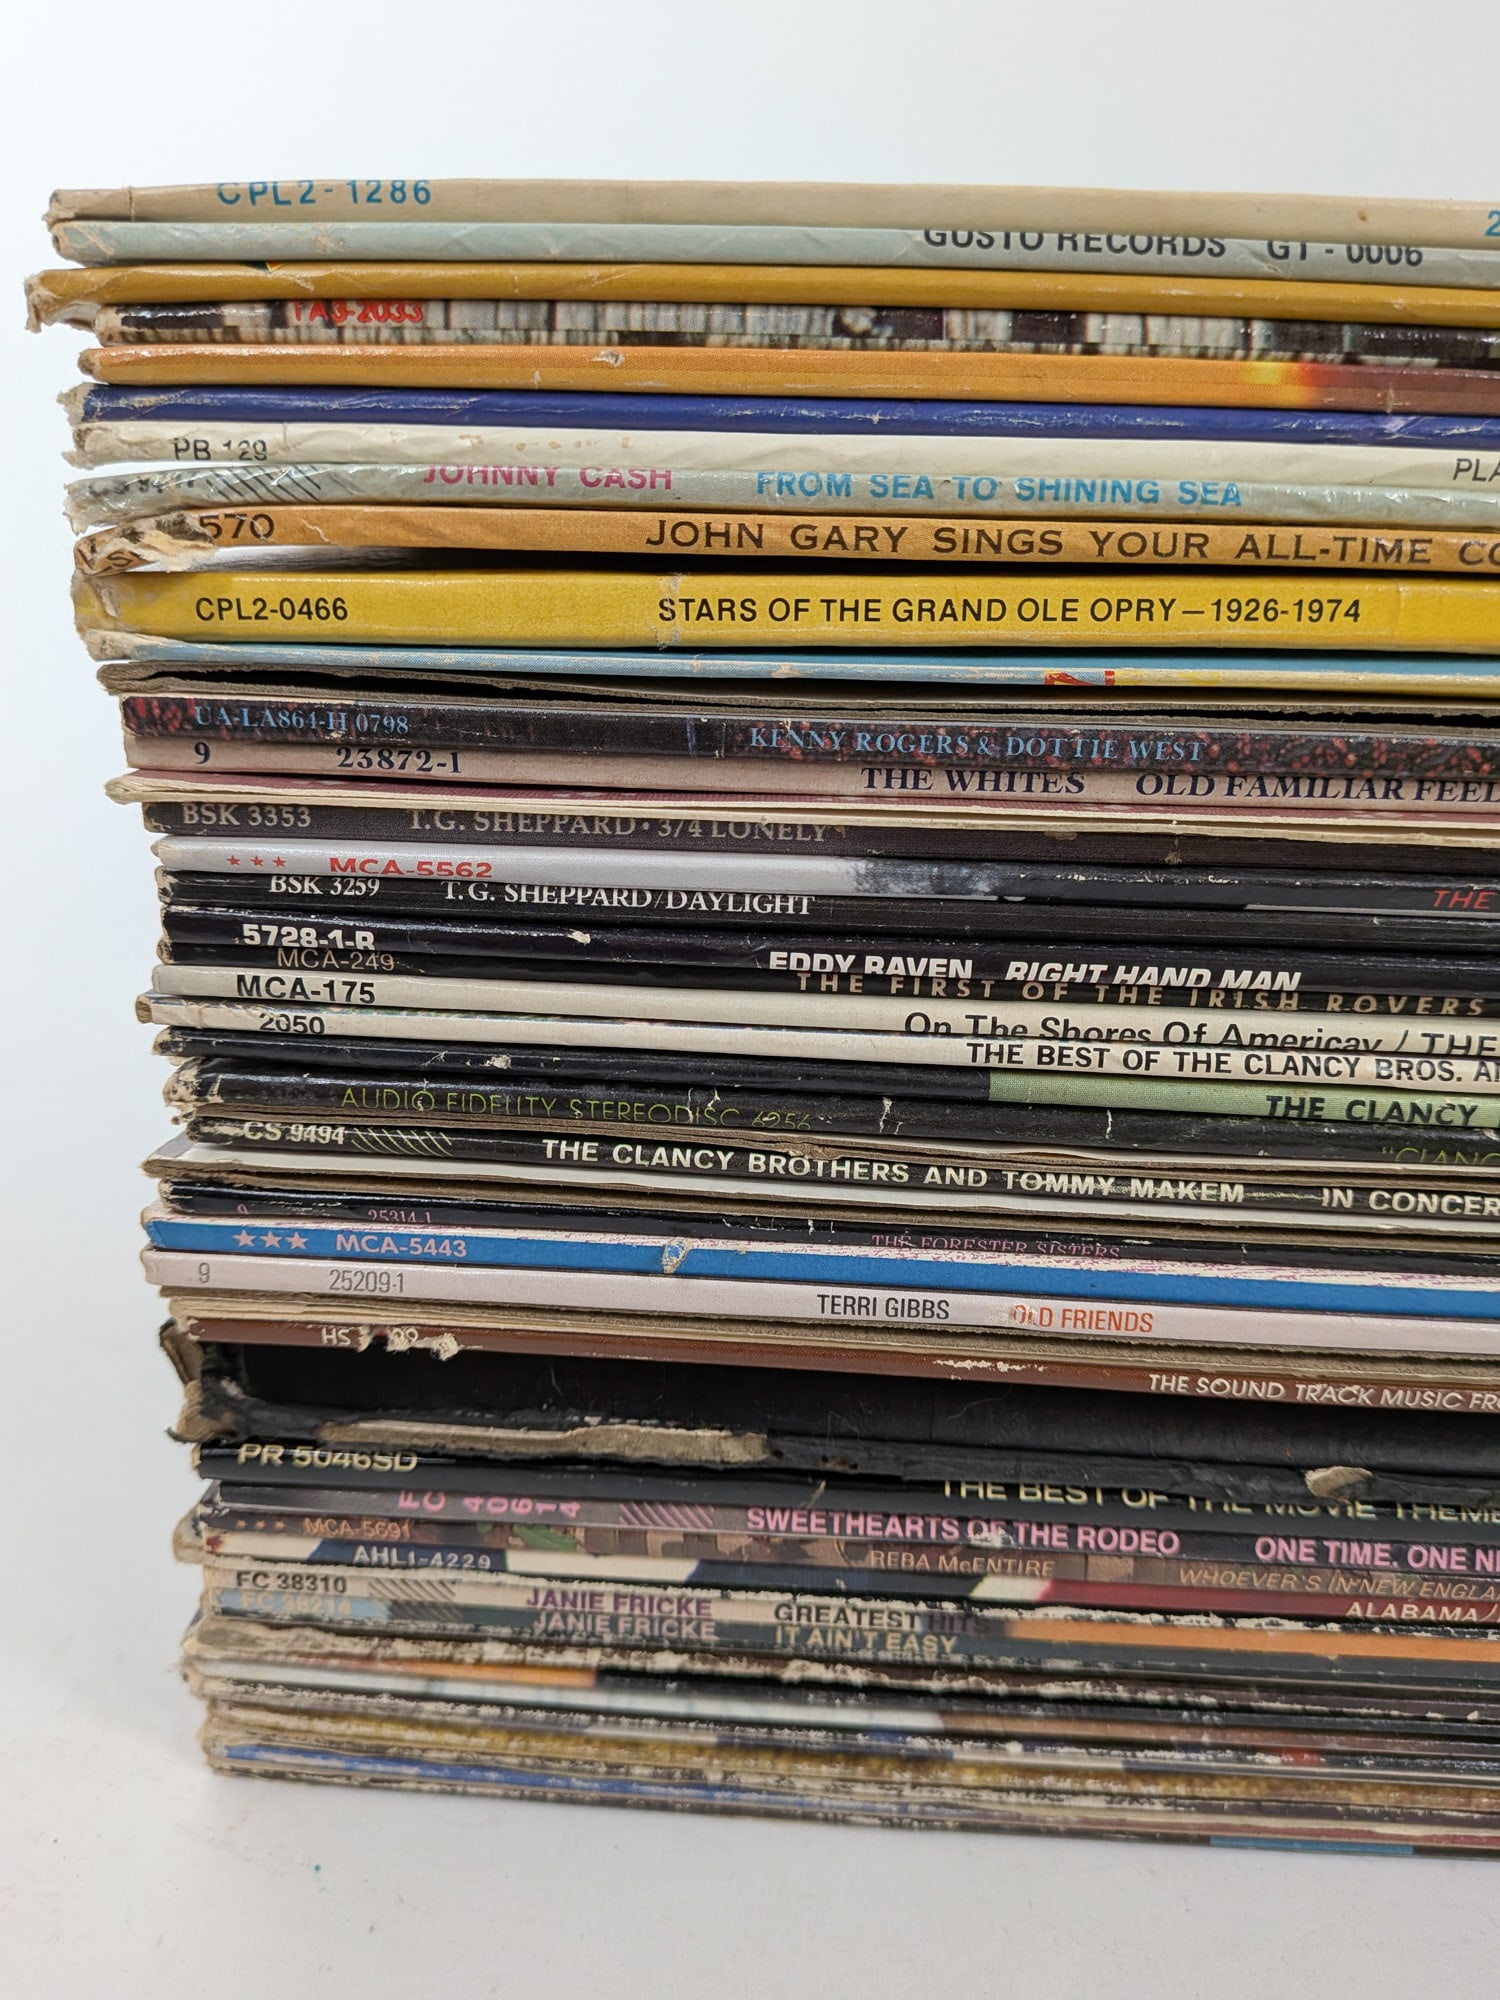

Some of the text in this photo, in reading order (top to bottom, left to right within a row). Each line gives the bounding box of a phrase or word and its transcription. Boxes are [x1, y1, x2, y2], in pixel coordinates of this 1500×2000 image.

[1057, 232, 1226, 257] RECORDS
[174, 437, 211, 461] PB
[423, 465, 672, 490] JOHNNY CASH
[757, 472, 1242, 507] FROM SEA TO SHINING SEA
[646, 520, 1433, 565] JOHN GARY SINGS YOUR ALL-TIME
[195, 597, 348, 622] CPL2-0466
[658, 597, 757, 622] STARS
[768, 597, 809, 622] OF
[820, 598, 881, 622] THE
[892, 598, 1007, 623] GRAND
[1017, 598, 1079, 622] OLE
[194, 742, 461, 774] 9 23872-1
[750, 727, 1207, 762] KENNY ROGERS & DOTTIE WEST
[861, 767, 933, 791] THE
[946, 769, 1085, 794] WHITES
[1136, 772, 1215, 796] OLD
[1225, 775, 1404, 801] FAMILIAR
[183, 804, 240, 826] BSK
[247, 805, 311, 828] 3353
[474, 811, 636, 836] SHEPPARD
[711, 820, 828, 842] LONELY
[329, 857, 493, 878] MCA-5562
[269, 875, 322, 895] BSK
[329, 877, 380, 897] 3259
[1432, 889, 1497, 909] THE
[242, 923, 1301, 992] 5728-1-R EDDY RAVEN RIGHT HAND MAN
[277, 948, 1484, 1016] MCA-249 THE FIRST OF THE IRISH ROVERS
[236, 974, 375, 1004] MCA-175
[904, 1012, 951, 1034] On
[965, 1014, 1027, 1038] The
[1039, 1016, 1151, 1042] Shores
[1163, 1021, 1207, 1044] Of
[1420, 1032, 1498, 1055] THE
[259, 1013, 1462, 1082] 2050 THE BEST OF THE CLANCY BROS.
[341, 1088, 435, 1111] AUDIO
[447, 1092, 557, 1116] FIDELITY
[569, 1099, 740, 1126] STEREODISC
[1266, 1095, 1478, 1127] THE CLANCY
[542, 1139, 598, 1162] THE
[613, 1143, 734, 1170] CLANCY
[749, 1153, 909, 1183] BROTHERS
[923, 1166, 988, 1188] AND
[1000, 1170, 1116, 1196] TOMMY
[1130, 1177, 1244, 1204] MAKEM
[1321, 1187, 1353, 1209] IN
[336, 1234, 467, 1257] MCA-5443
[198, 1262, 210, 1283] 9
[817, 1294, 1154, 1333] TERRI GIBBS OLD FRIENDS
[322, 1327, 351, 1345] HS
[1149, 1373, 1190, 1393] THE
[1196, 1377, 1285, 1399] SOUND
[1295, 1382, 1377, 1405] TRACK
[1380, 1388, 1464, 1408] MUSIC
[237, 1443, 285, 1466] PR
[747, 1507, 960, 1540] SWEETHEARTS
[1014, 1522, 1070, 1548] THE
[1077, 1525, 1181, 1554] RODEO
[1255, 1535, 1317, 1563] ONE
[1407, 1544, 1467, 1570] ONE
[236, 1571, 347, 1593] FC 38310
[870, 1550, 930, 1570] REBA
[937, 1554, 1055, 1577] McENTIRE
[1359, 1576, 1415, 1596] NEW
[1419, 1580, 1500, 1600] ENGLA
[527, 1587, 605, 1610] JANIE
[613, 1591, 713, 1617] FRICKE
[774, 1603, 920, 1629] GREATEST
[533, 1610, 611, 1635] JANIE
[617, 1614, 716, 1639] FRICKE
[775, 1625, 799, 1646] IT
[886, 1632, 958, 1653] EASY
